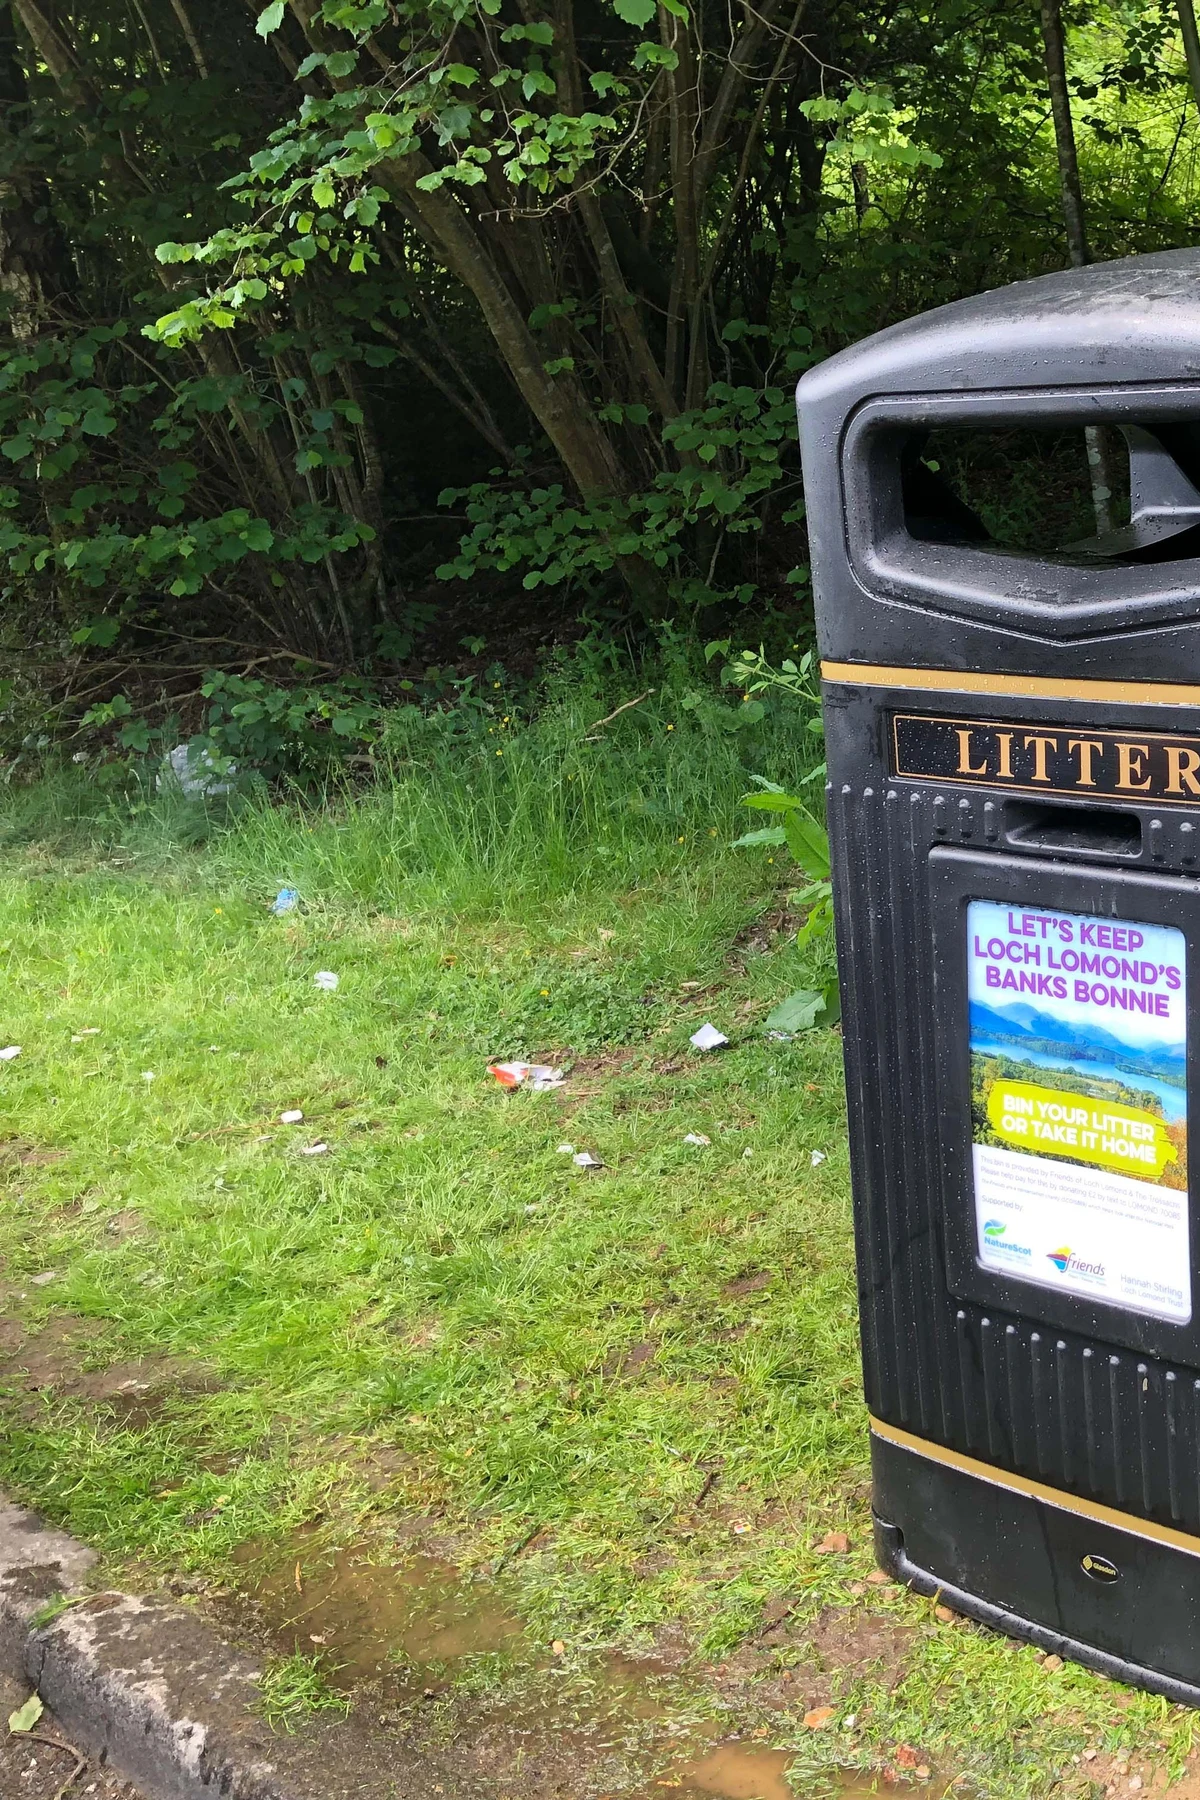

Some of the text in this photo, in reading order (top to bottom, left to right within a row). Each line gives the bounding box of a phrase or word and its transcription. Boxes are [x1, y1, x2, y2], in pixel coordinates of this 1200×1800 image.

[1008, 912, 1144, 953] LET'S KEEP
[974, 935, 1181, 990] LOCH LOMOND'S
[986, 965, 1169, 1018] BANKS BONNIE
[1003, 1093, 1154, 1142] BIN YOUR LITTER
[1001, 1115, 1157, 1164] OR TAKE IT HOME
[980, 1154, 993, 1165] This
[1041, 1169, 1049, 1179] by
[984, 1236, 1032, 1256] NatureScot
[1060, 1253, 1106, 1277] friends
[1120, 1273, 1152, 1290] Hannah
[1153, 1281, 1183, 1300] Stirling
